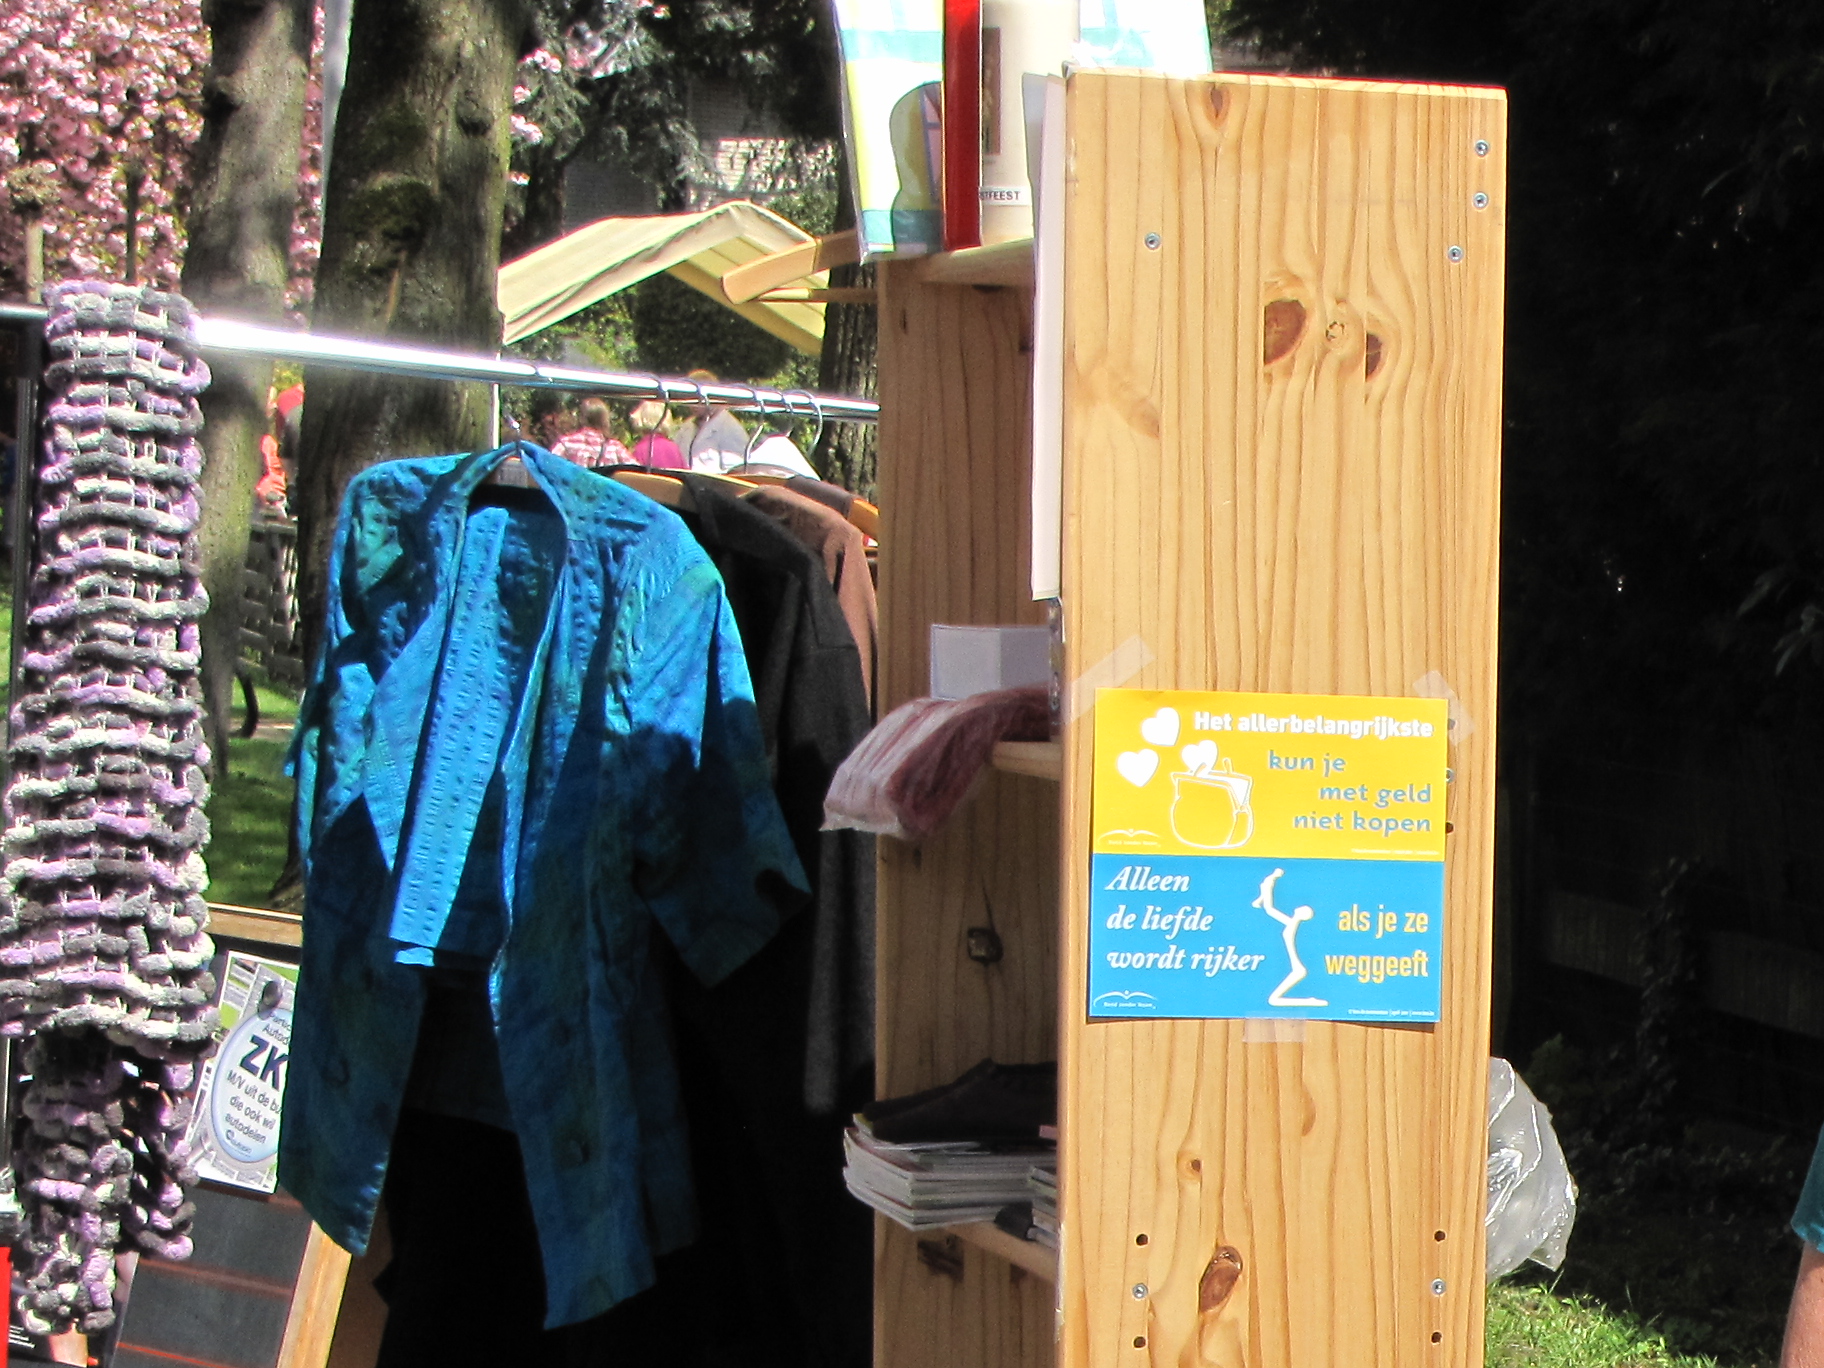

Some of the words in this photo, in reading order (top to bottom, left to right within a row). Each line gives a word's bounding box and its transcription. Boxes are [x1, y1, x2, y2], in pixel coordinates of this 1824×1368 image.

[1194, 711, 1232, 731] Het
[1238, 713, 1434, 740] allerbelangrijkste
[1269, 750, 1314, 770] kun
[1322, 753, 1346, 777] je
[1320, 785, 1368, 801] met
[1374, 783, 1431, 808] geld
[1293, 812, 1343, 830] niet
[1352, 812, 1431, 837] kopen
[1105, 866, 1190, 892] Alleen
[1106, 905, 1137, 931] de
[1141, 905, 1214, 940] liefde
[1338, 904, 1370, 932] als
[1375, 905, 1398, 938] je
[1403, 911, 1429, 933] ze
[1106, 945, 1186, 971] wordt
[1190, 946, 1266, 977] rijker
[1325, 951, 1430, 984] weggeeft
[240, 1034, 289, 1092] ZK
[230, 1096, 243, 1112] die
[244, 1105, 262, 1124] ook
[258, 1091, 270, 1105] de
[225, 1112, 267, 1144] autodelen
